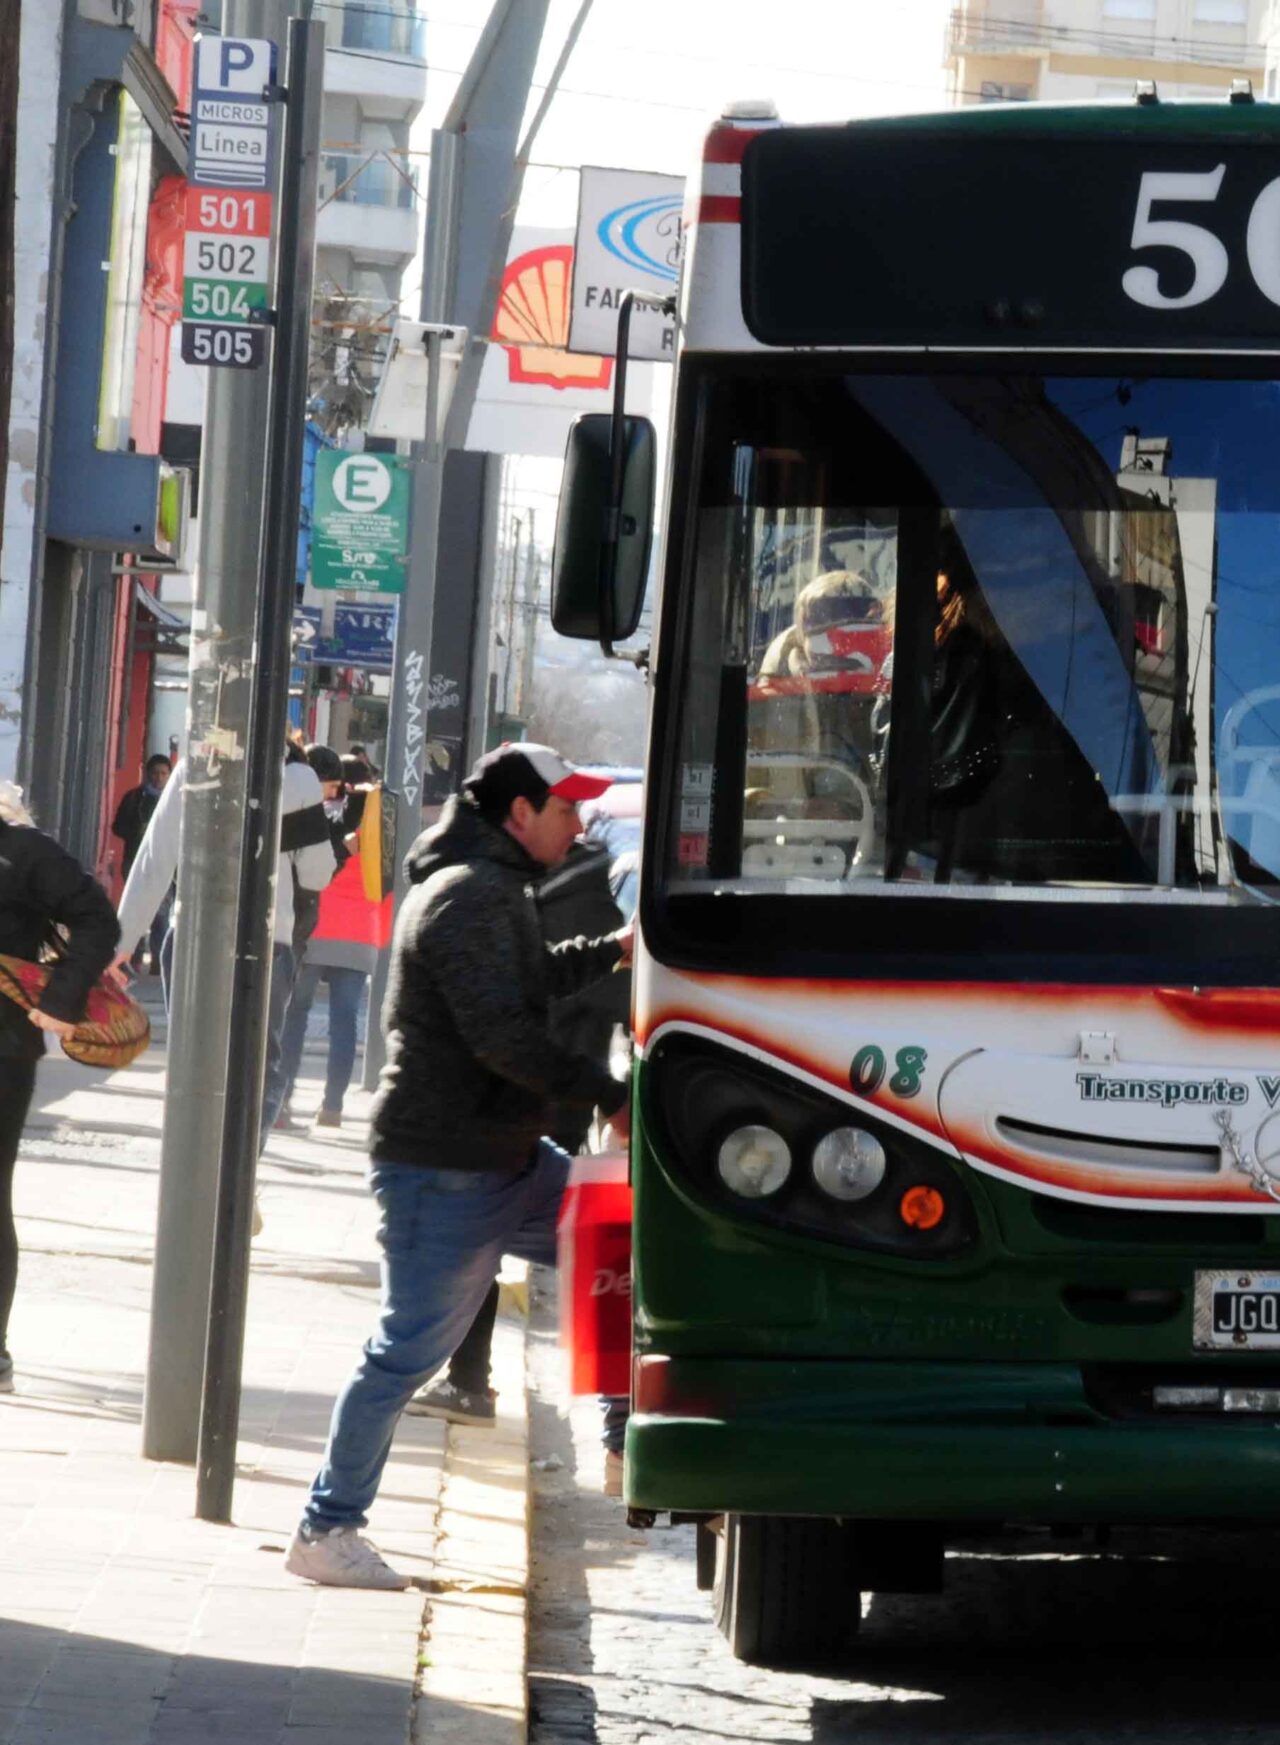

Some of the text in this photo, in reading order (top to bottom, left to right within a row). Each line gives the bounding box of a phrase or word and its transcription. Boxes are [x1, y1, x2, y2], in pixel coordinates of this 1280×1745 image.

[220, 40, 255, 88] P
[201, 103, 264, 122] MICROS
[200, 131, 262, 156] Línea
[199, 194, 256, 231] 501
[197, 240, 256, 275] 502
[191, 282, 250, 319] 504
[193, 328, 253, 364] 505
[345, 463, 378, 504] E
[848, 1044, 928, 1099] 08
[1076, 1073, 1249, 1108] Transporte
[1218, 1295, 1278, 1331] JGQ
